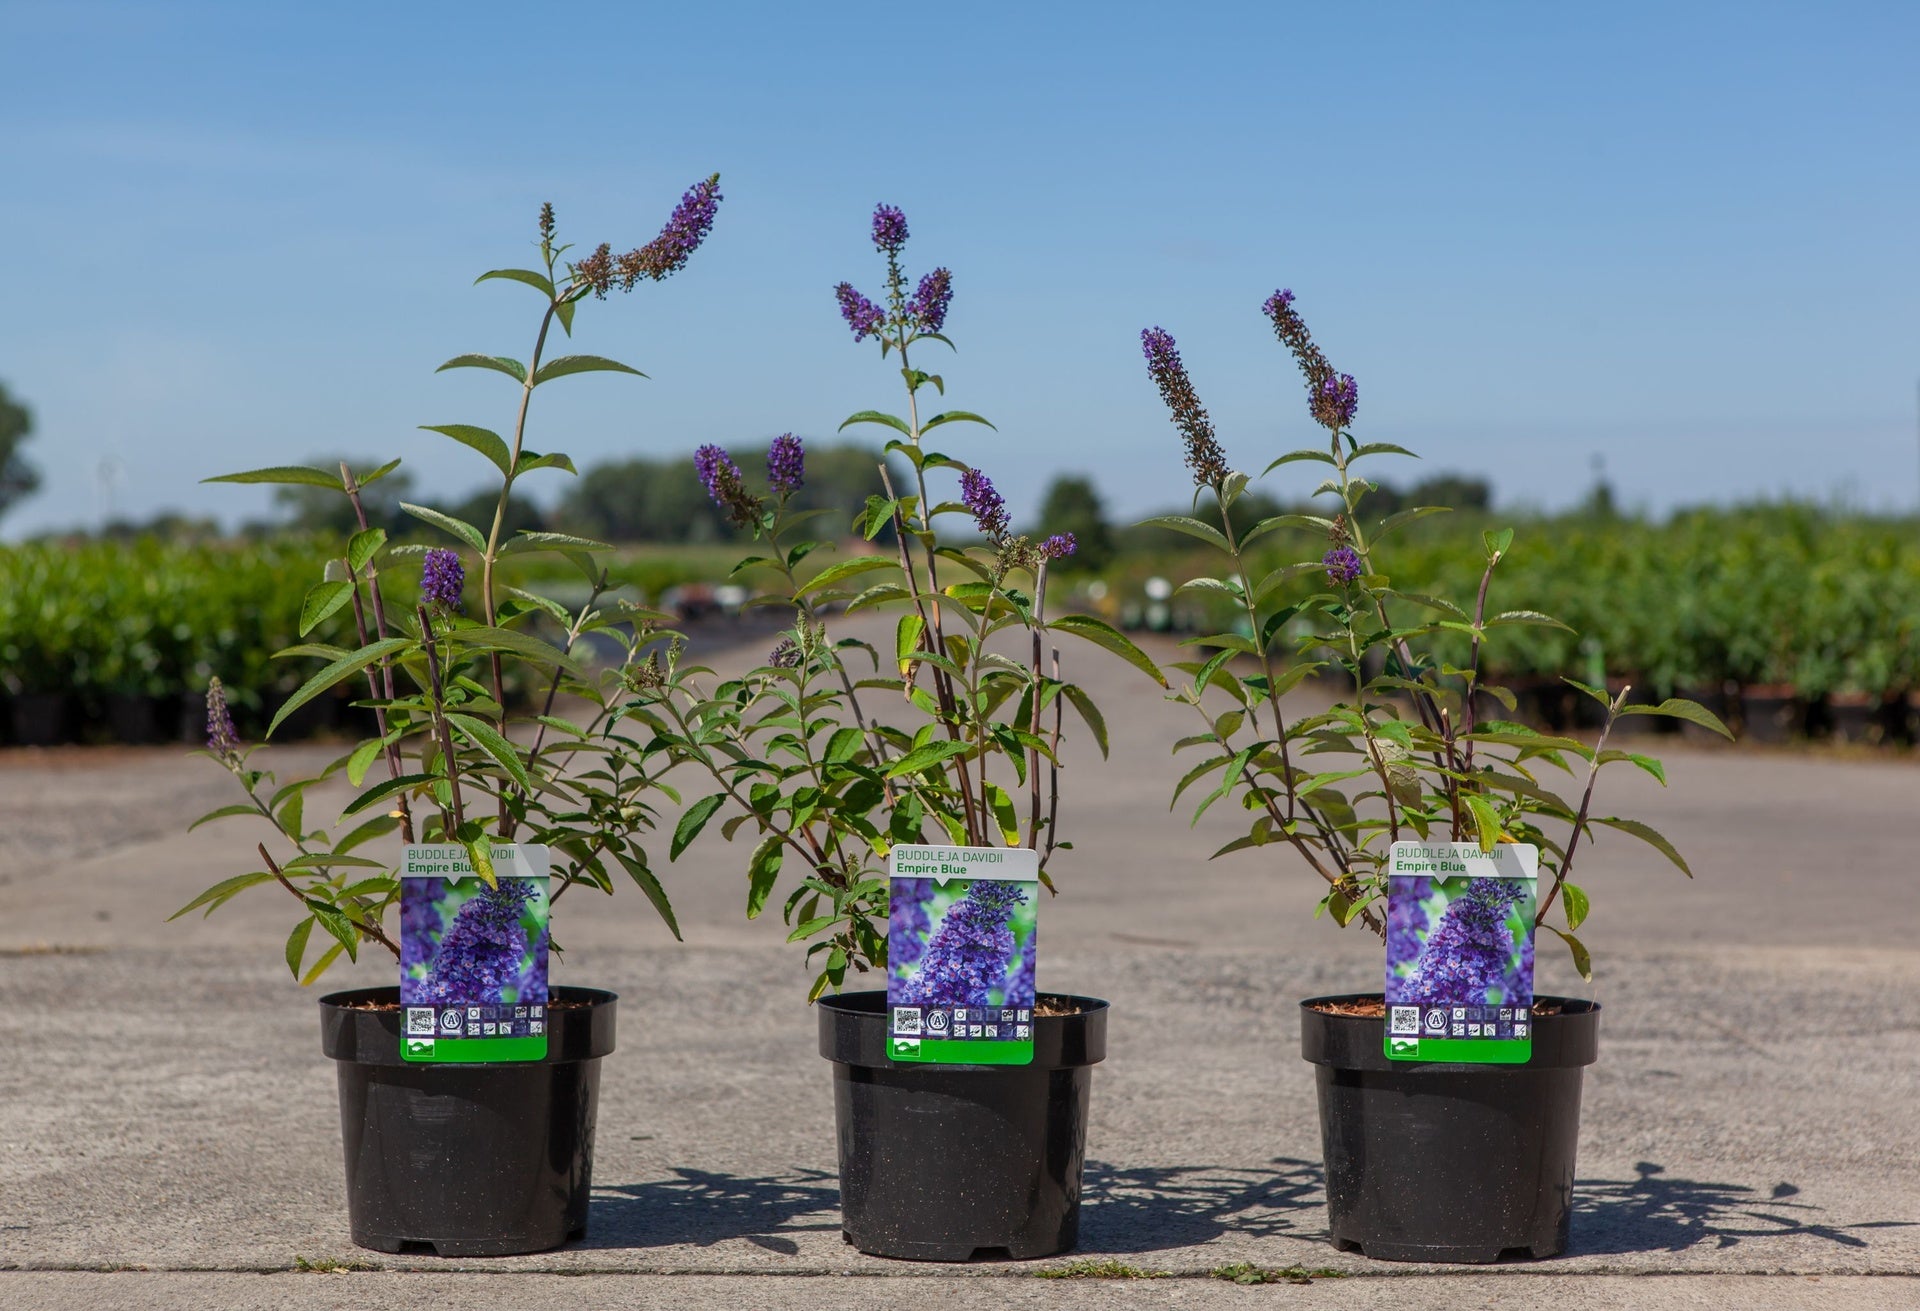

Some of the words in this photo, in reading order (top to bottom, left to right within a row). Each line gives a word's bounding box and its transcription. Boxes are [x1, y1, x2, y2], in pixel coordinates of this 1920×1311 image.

[489, 849, 515, 860] VIDII
[897, 849, 960, 862] BUDDLEJA
[962, 852, 1003, 863] DAVIDII
[1397, 847, 1459, 859] BUDDLEJA
[408, 862, 450, 875] Empire
[452, 862, 473, 873] Blu
[896, 862, 938, 875] Empire
[941, 864, 967, 875] Blue
[1396, 860, 1438, 873] Empire
[1440, 861, 1466, 872] Blue
